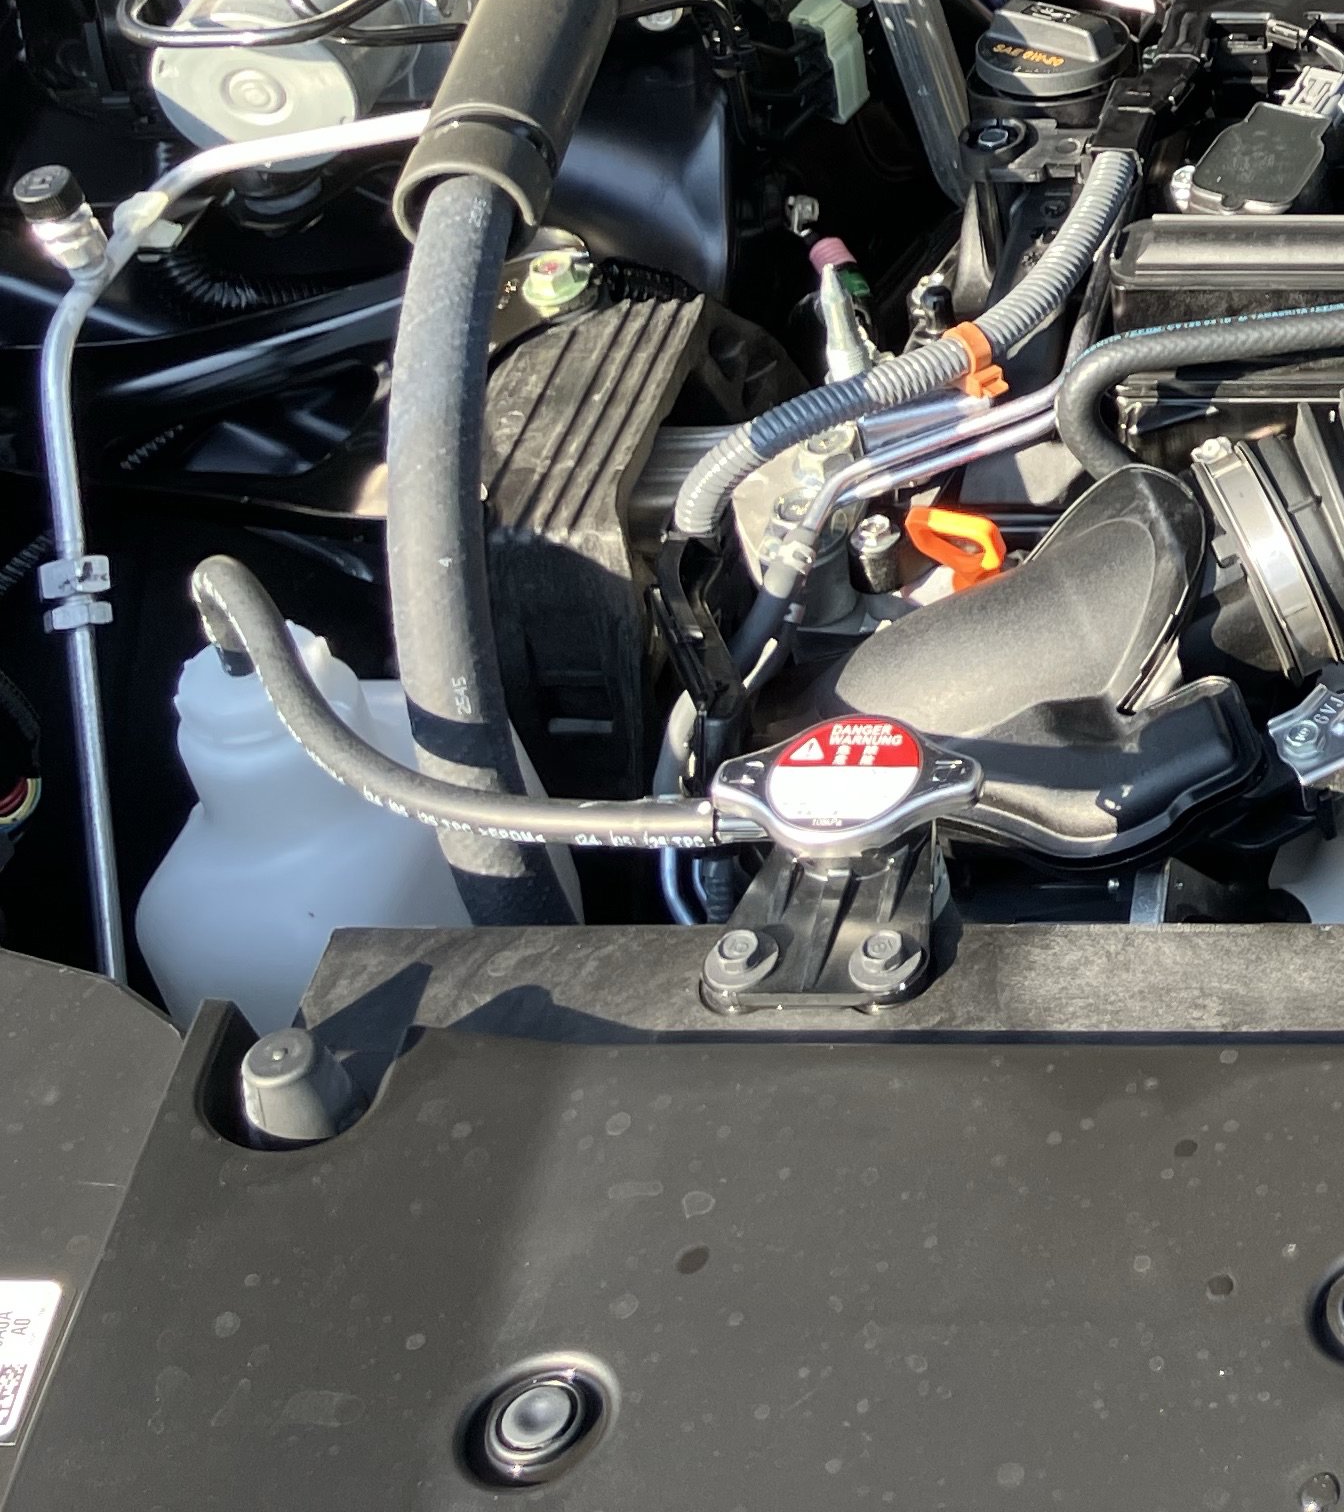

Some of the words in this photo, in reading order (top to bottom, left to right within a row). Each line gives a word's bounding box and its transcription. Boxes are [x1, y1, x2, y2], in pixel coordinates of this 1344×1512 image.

[992, 43, 1025, 57] SAE
[451, 675, 472, 715] 2545
[831, 723, 893, 735] DANGER
[829, 734, 903, 747] WARNUNG
